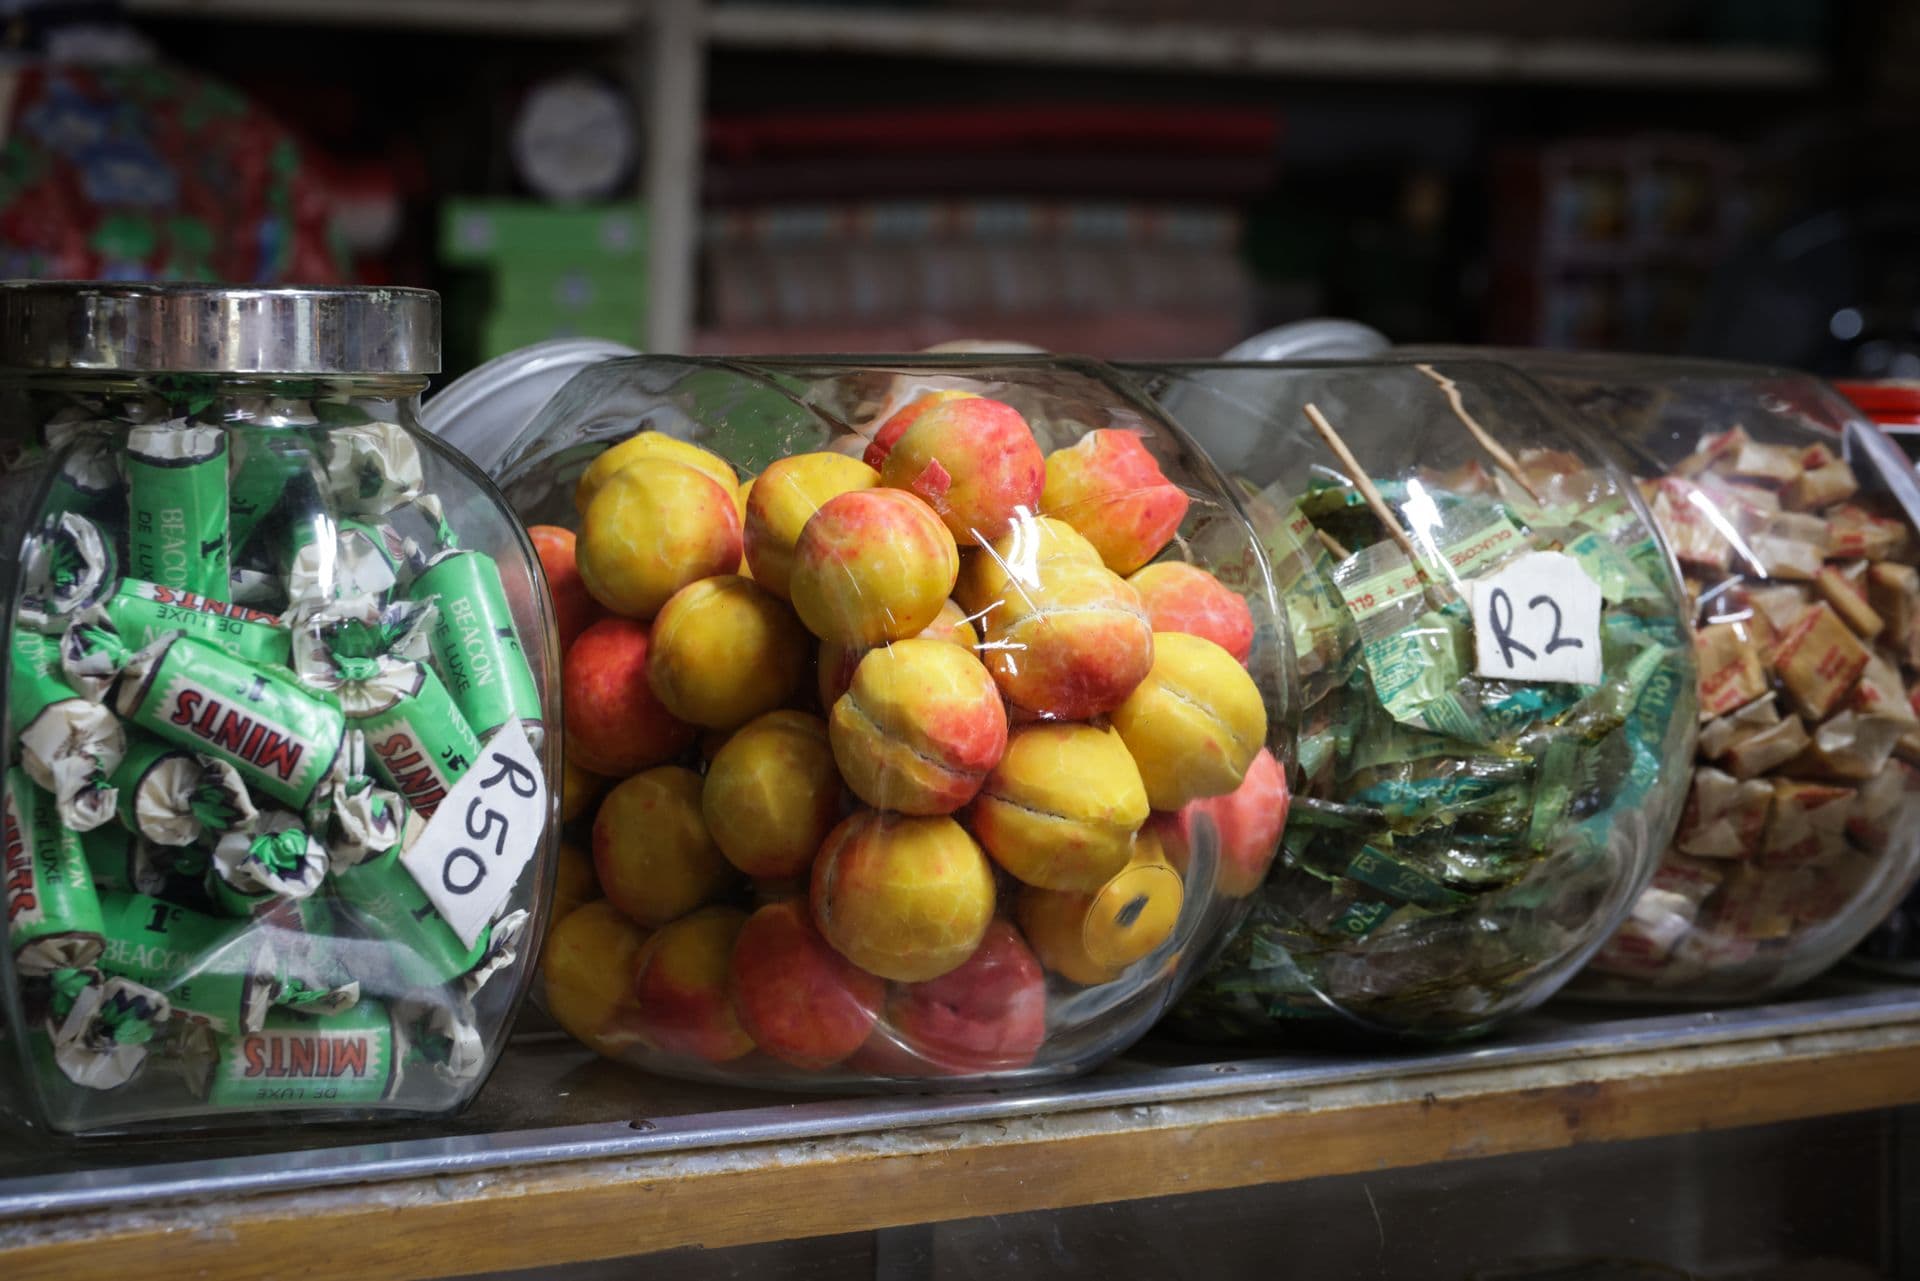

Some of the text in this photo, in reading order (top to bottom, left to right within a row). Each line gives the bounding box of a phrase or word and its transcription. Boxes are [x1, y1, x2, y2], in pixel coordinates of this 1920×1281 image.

[138, 511, 152, 580] DE LUX
[156, 605, 243, 635] DE LUXE
[451, 596, 497, 687] BEACON
[1489, 588, 1583, 668] R2
[446, 642, 471, 696] LUXE
[168, 689, 304, 781] MINTS
[442, 752, 538, 895] R50
[40, 839, 62, 885] LUXE
[244, 1036, 368, 1078] MINTS
[257, 1087, 305, 1100] LUXE
